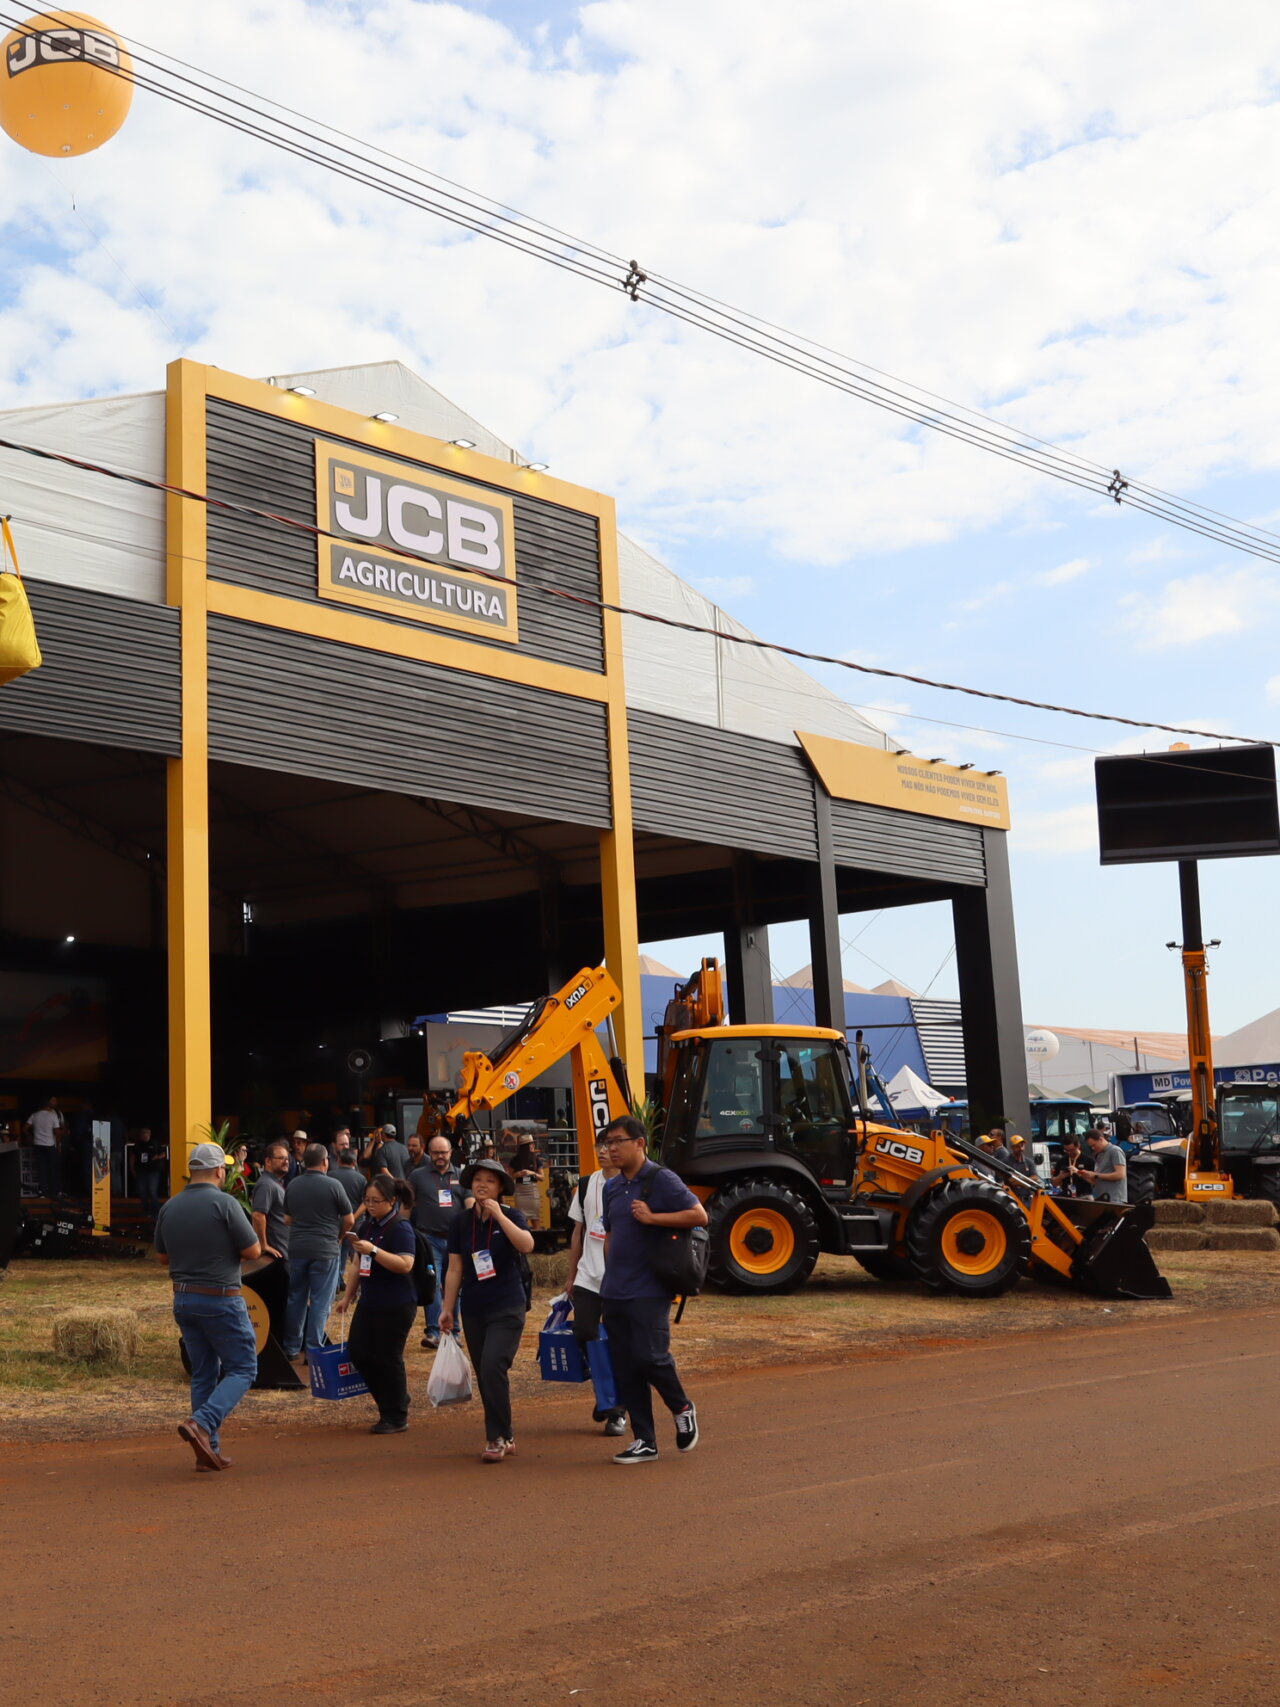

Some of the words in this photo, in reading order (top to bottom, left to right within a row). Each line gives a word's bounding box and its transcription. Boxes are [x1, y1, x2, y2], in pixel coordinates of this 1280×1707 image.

[9, 29, 120, 73] JCB
[335, 475, 502, 570] JCB
[339, 557, 504, 620] AGRICULTURA
[1154, 1077, 1171, 1087] MD
[1173, 1077, 1192, 1087] Pow
[1252, 1070, 1280, 1082] Pe
[590, 1081, 610, 1137] JC
[876, 1139, 923, 1164] JCB
[1193, 1183, 1225, 1191] JCB
[57, 1221, 74, 1230] JCB
